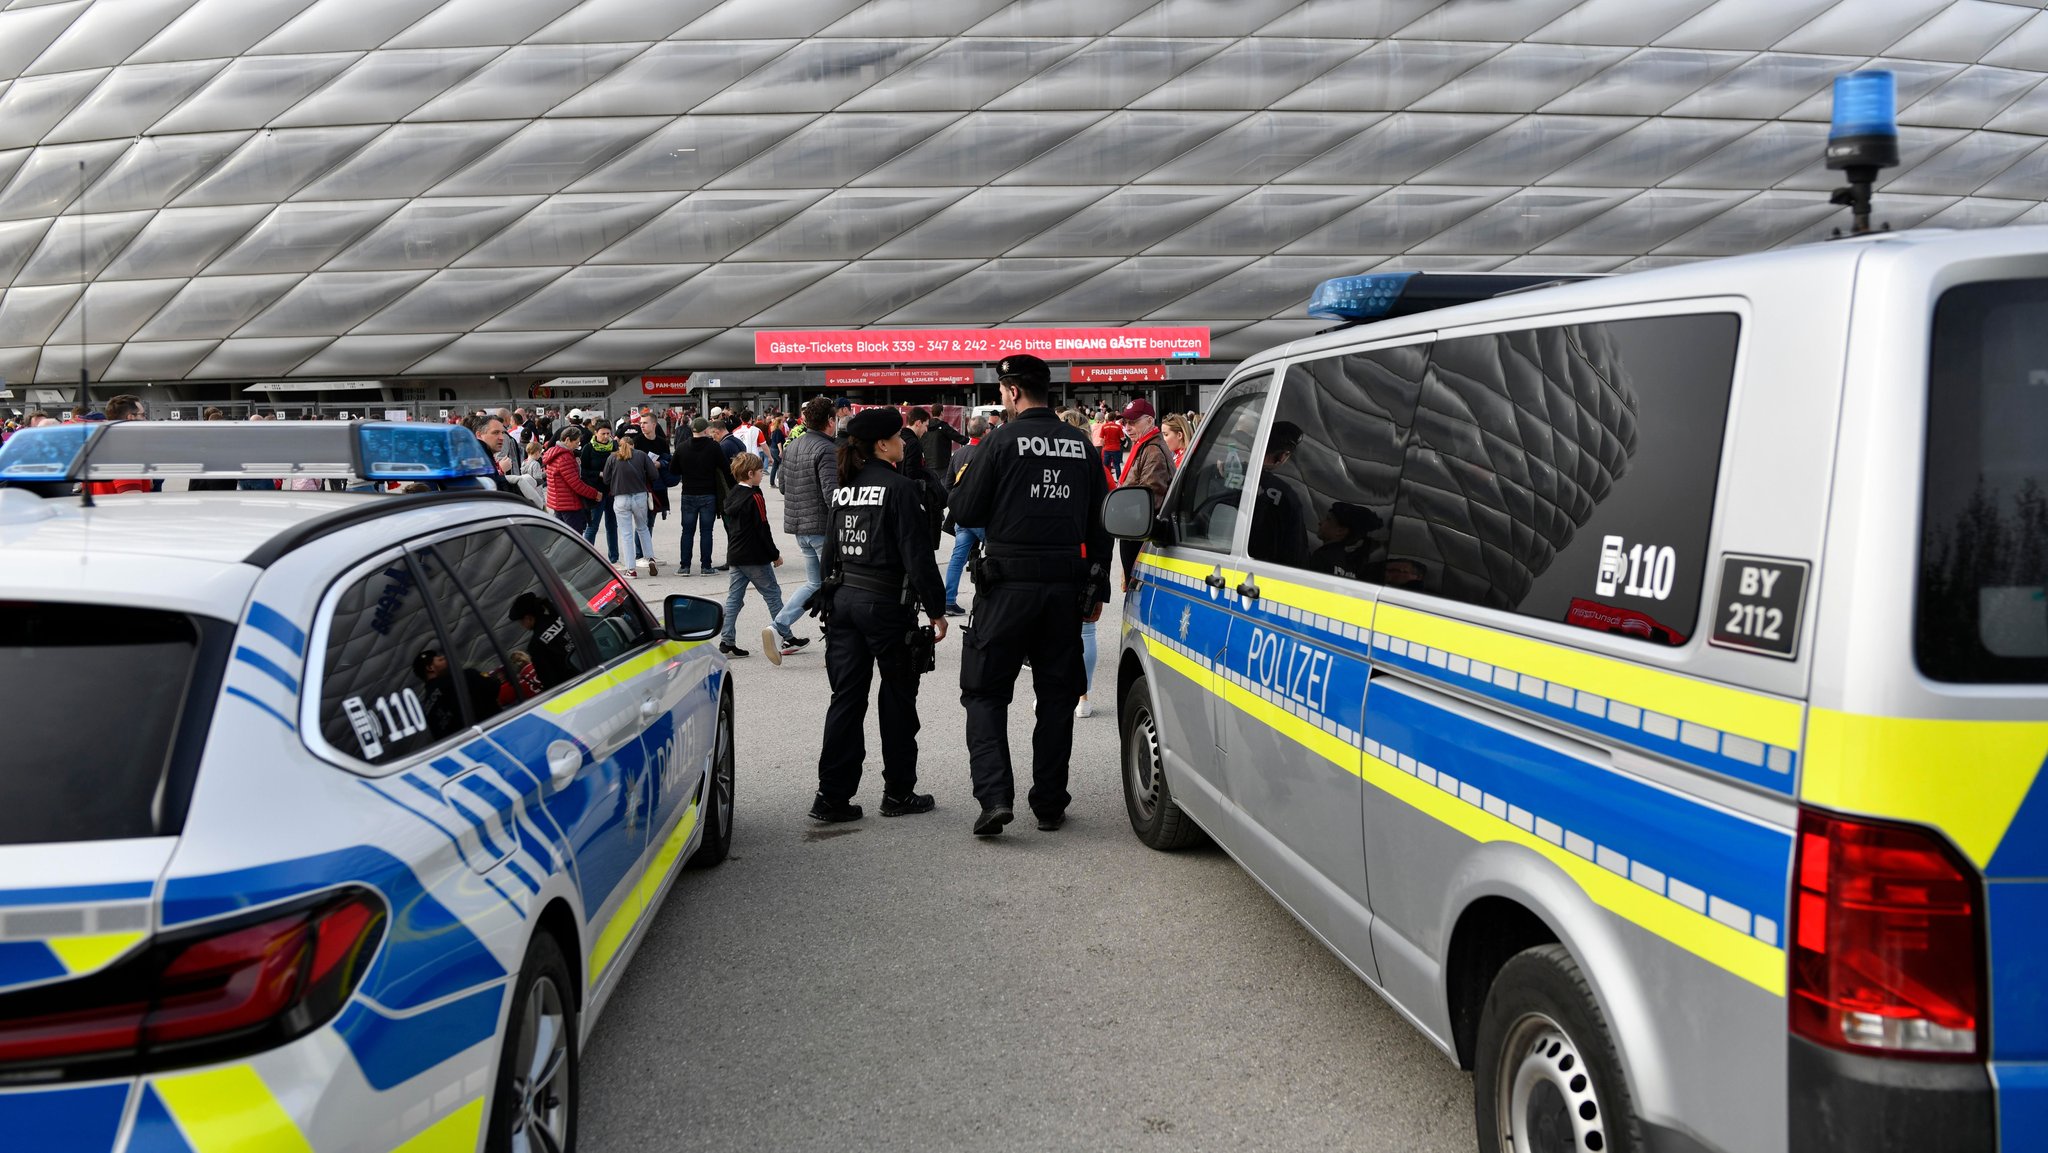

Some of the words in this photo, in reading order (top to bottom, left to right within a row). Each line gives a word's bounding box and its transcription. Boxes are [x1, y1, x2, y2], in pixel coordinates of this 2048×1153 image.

[770, 341, 853, 353] Gäste-Tickets
[856, 341, 890, 352] Block
[892, 340, 915, 352] 339
[927, 340, 948, 351] 347
[952, 340, 962, 351] &
[964, 340, 987, 351] 242
[999, 339, 1022, 350] 246
[1025, 338, 1052, 350] bitte
[1055, 338, 1107, 350] EINGANG
[1110, 336, 1147, 349] GÄSTE
[1150, 338, 1202, 349] benutzen
[1017, 436, 1086, 459] POLIZEI
[1043, 469, 1061, 483] BY
[832, 486, 886, 507] POLIZEI
[1030, 484, 1040, 498] M
[1043, 484, 1070, 498] 7240
[845, 515, 858, 528] BY
[845, 530, 866, 543] 7240
[1624, 544, 1676, 600] 110
[1738, 566, 1781, 598] BY
[1725, 602, 1783, 640] 2112
[1248, 627, 1333, 714] POLIZEI
[376, 688, 427, 742] 110
